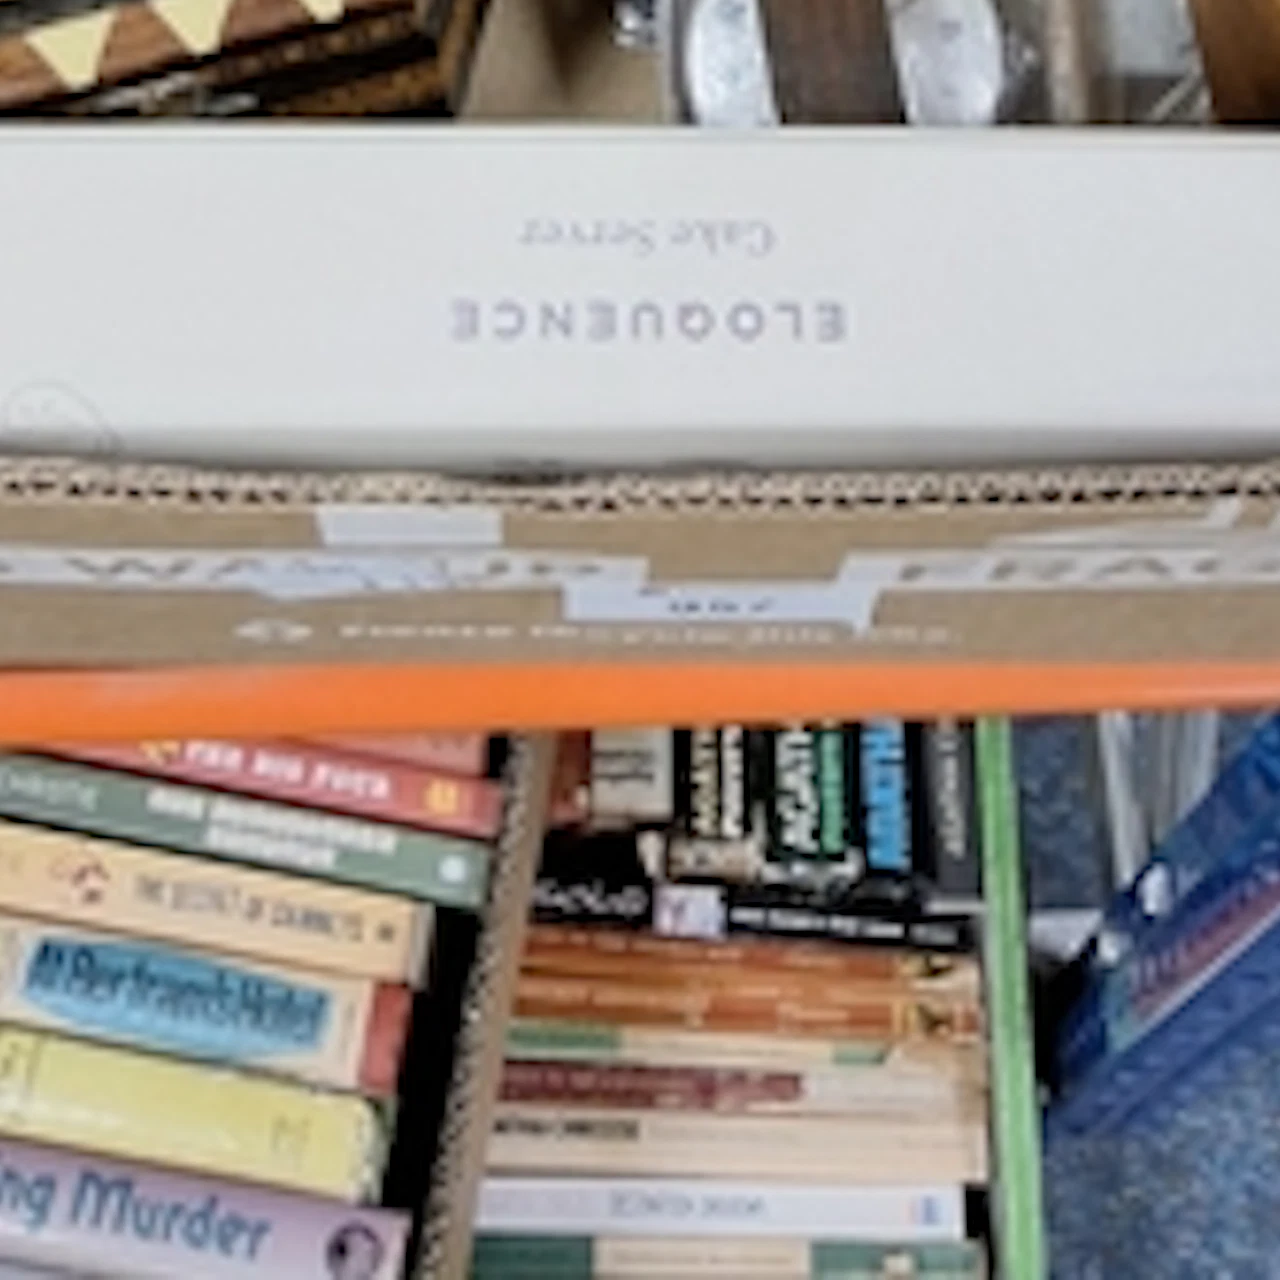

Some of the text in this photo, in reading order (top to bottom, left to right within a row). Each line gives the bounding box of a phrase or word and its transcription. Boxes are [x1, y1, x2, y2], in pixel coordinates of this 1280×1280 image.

[518, 217, 777, 259] Cake Server
[451, 298, 848, 343] ELOQUENCE
[688, 726, 720, 837] AGATH
[774, 724, 820, 853] AGATH
[71, 1167, 272, 1262] Murder
